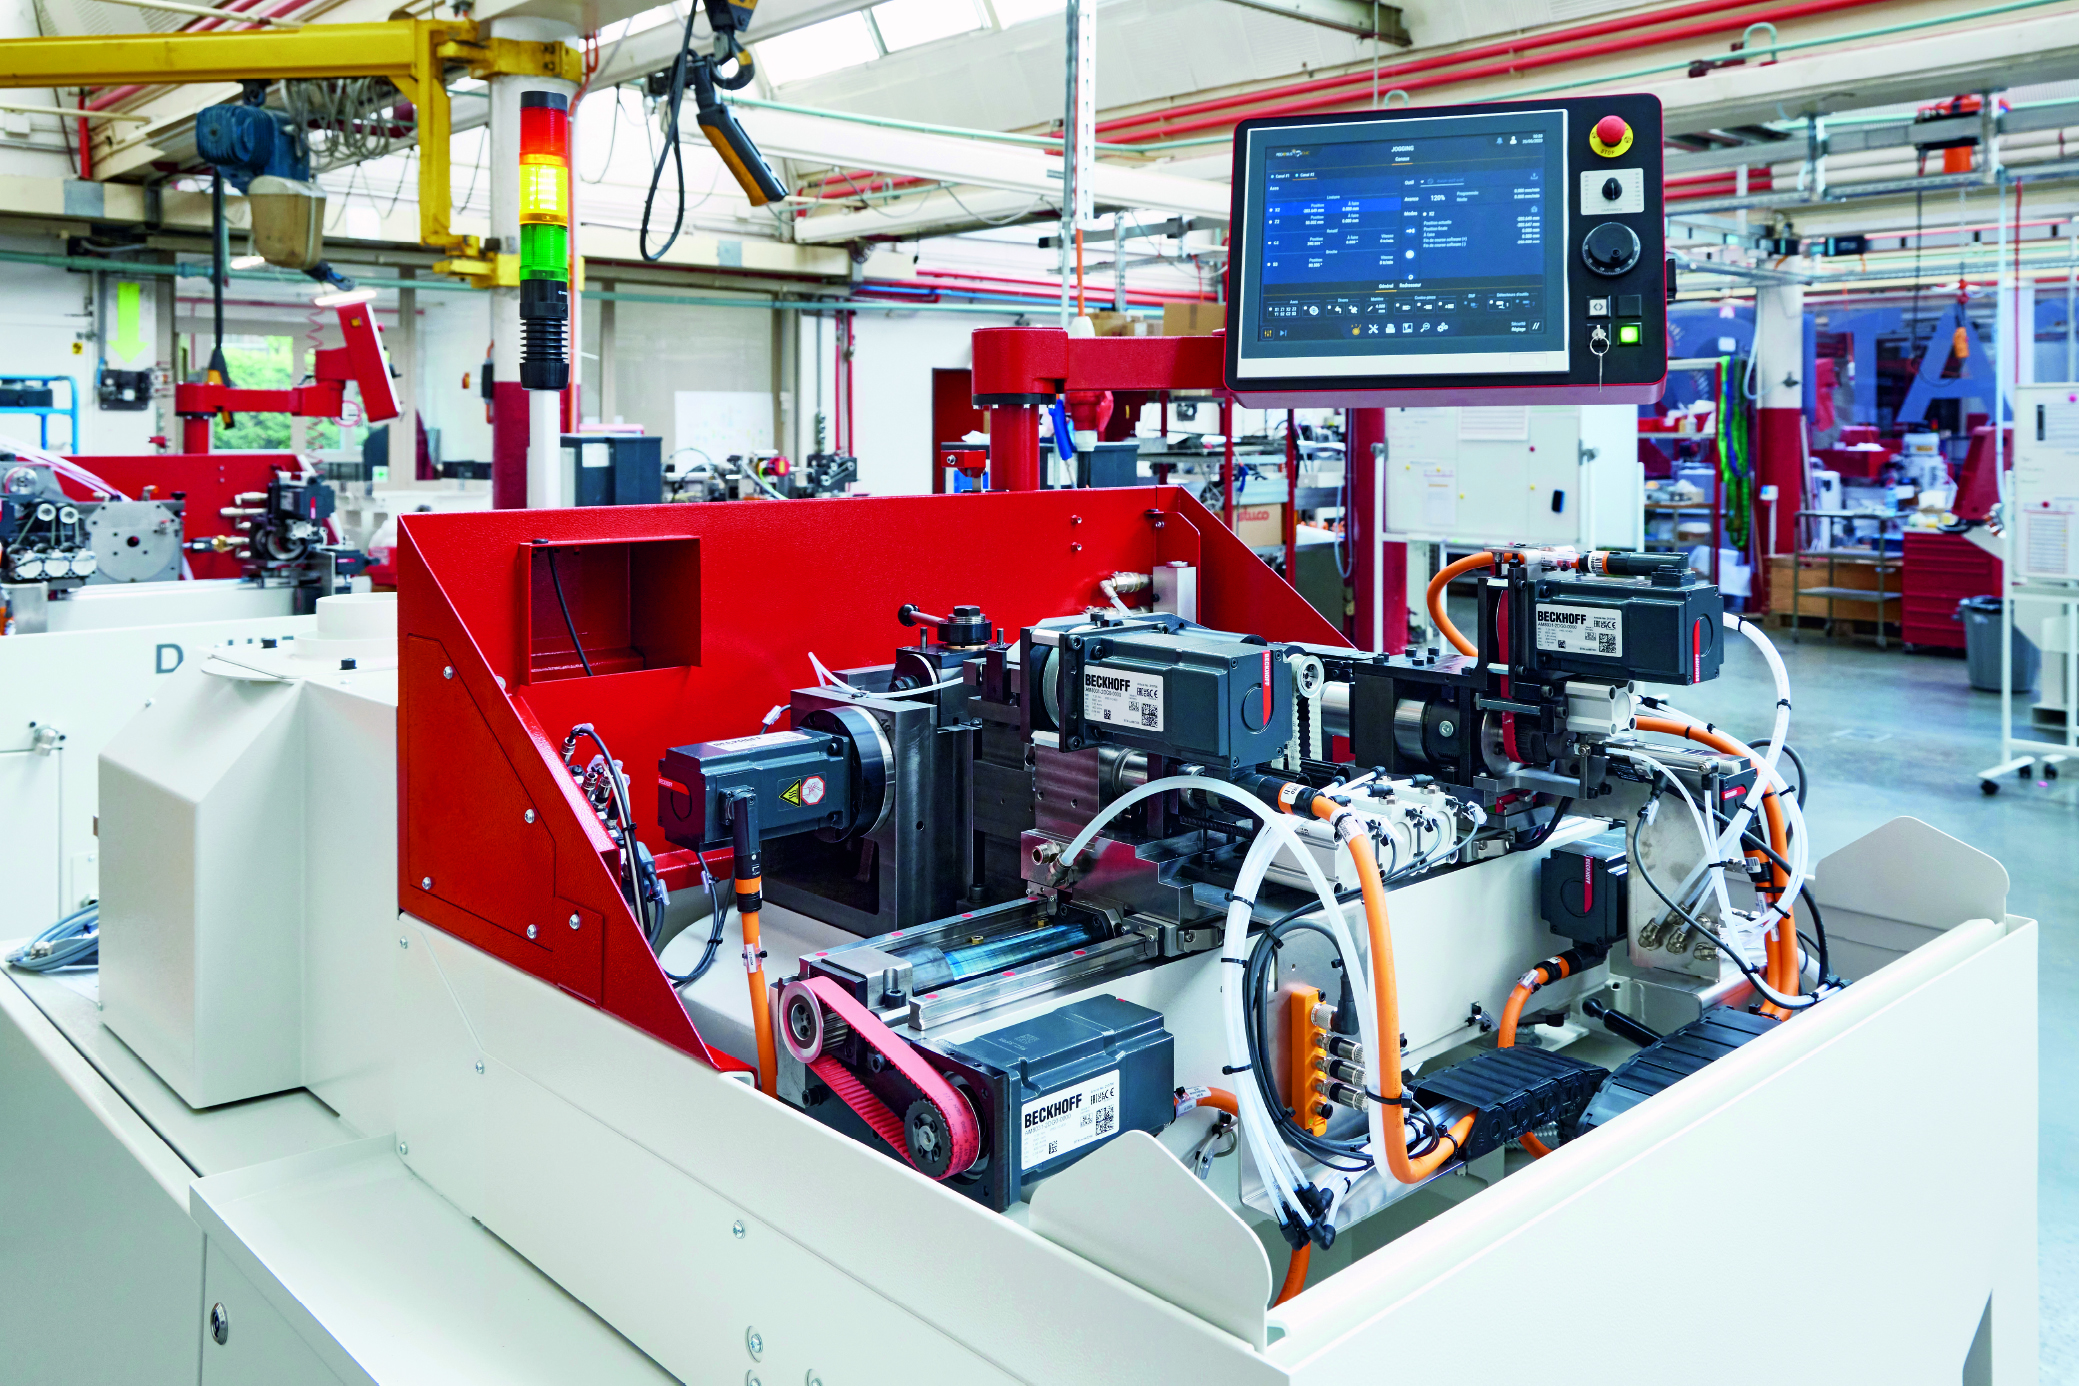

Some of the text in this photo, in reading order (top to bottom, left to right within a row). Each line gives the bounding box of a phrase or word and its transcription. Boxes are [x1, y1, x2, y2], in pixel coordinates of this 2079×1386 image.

[1600, 148, 1615, 156] STOP
[1537, 610, 1587, 625] BECKHOFF
[1085, 674, 1130, 692] BECKHOFF
[1024, 1093, 1082, 1129] BECKHOFF
